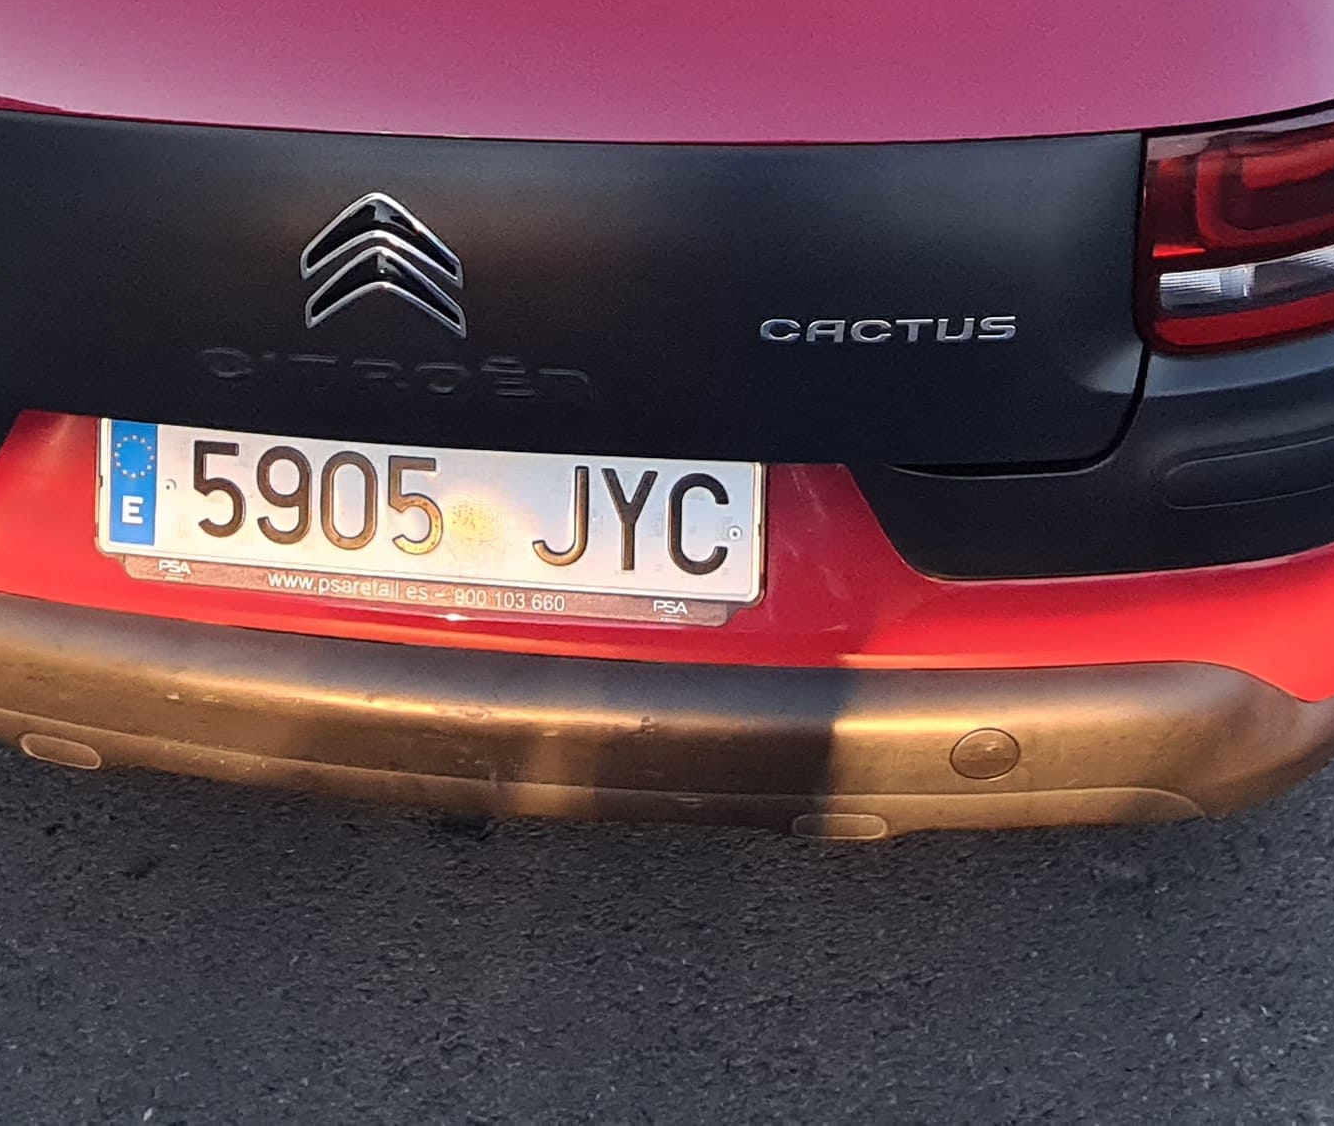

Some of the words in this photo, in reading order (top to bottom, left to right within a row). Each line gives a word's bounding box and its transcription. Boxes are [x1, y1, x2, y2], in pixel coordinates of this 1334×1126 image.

[760, 316, 1017, 343] CACTUS
[121, 496, 143, 525] E
[193, 439, 444, 555] 5905
[532, 464, 730, 576] JYC
[158, 558, 192, 576] PSA
[267, 572, 428, 603] www.psaretailes
[495, 591, 525, 610] 103
[531, 593, 565, 612] 660
[653, 599, 689, 615] PSA
